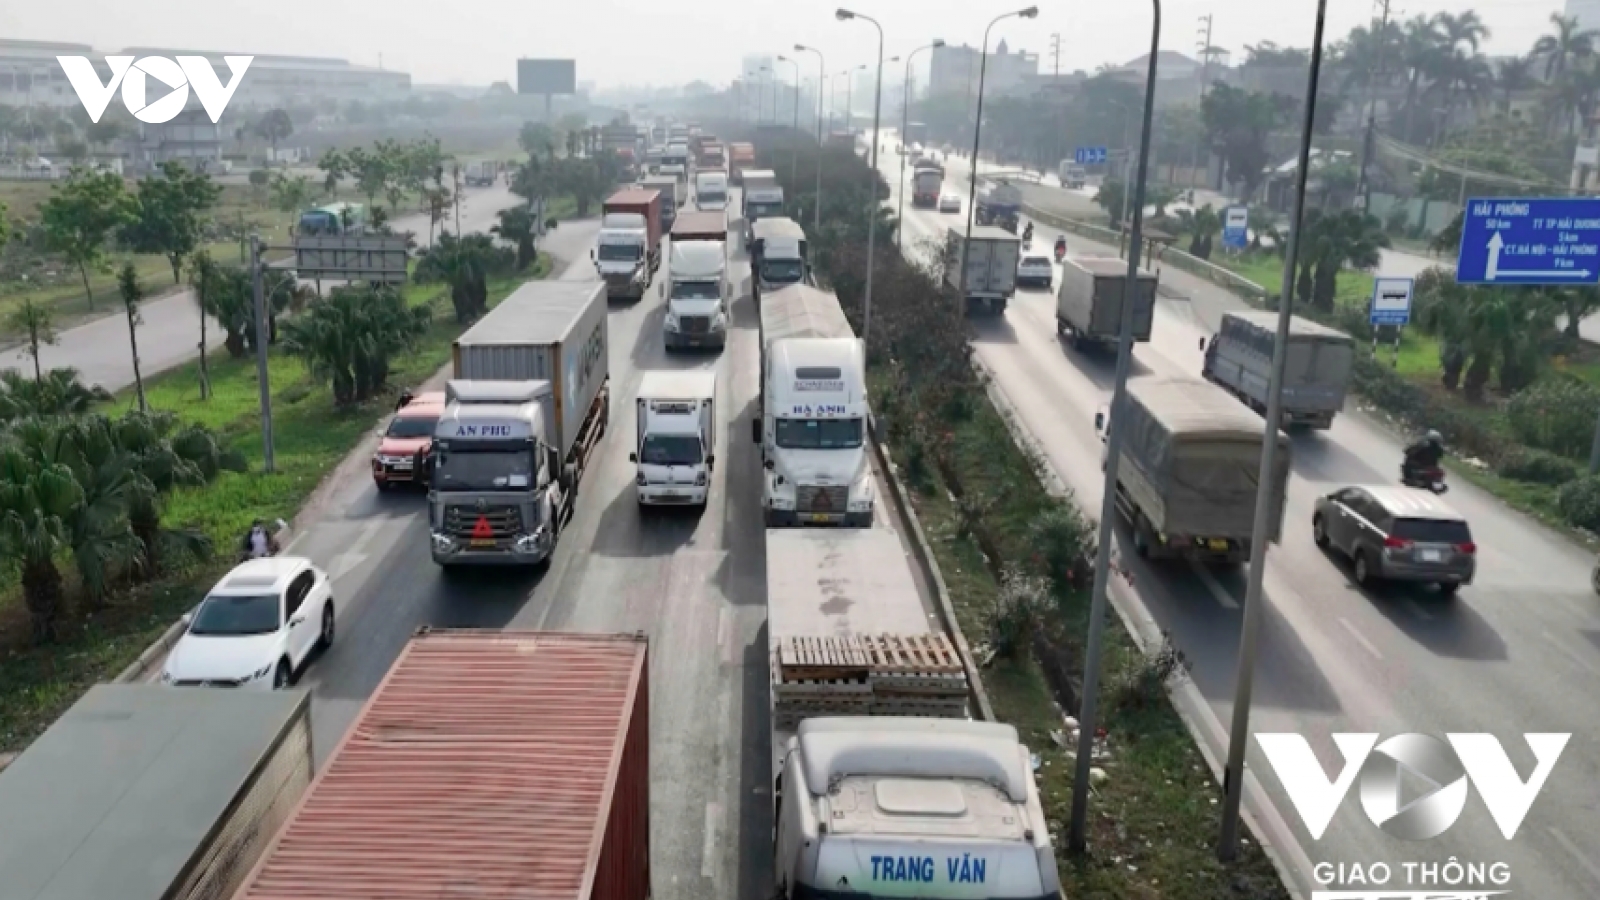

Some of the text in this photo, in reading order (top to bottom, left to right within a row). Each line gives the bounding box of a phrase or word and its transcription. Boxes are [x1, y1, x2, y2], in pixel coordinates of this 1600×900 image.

[817, 404, 845, 414] ANH
[456, 425, 478, 436] AN
[871, 853, 986, 883] TRANG VĂN
